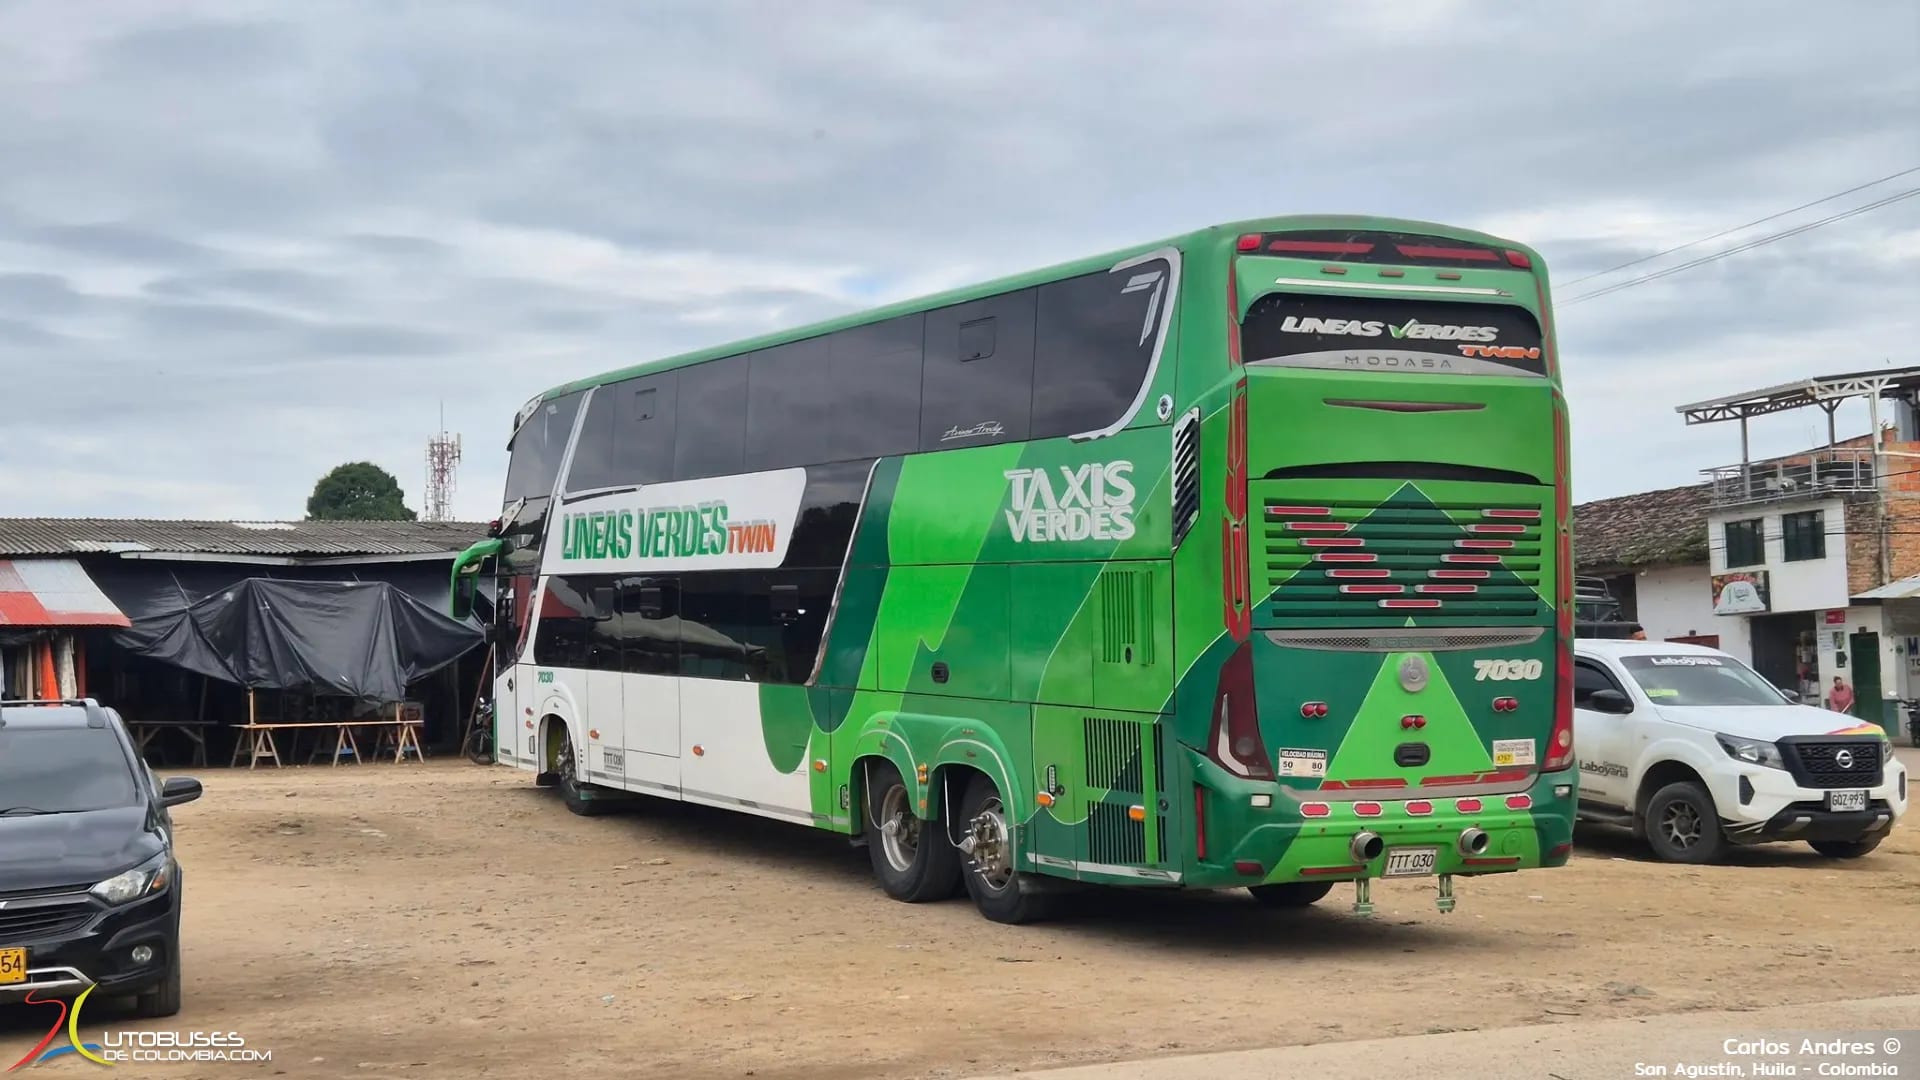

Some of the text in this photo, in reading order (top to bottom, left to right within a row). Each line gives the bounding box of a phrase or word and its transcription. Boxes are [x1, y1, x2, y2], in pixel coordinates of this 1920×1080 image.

[1281, 316, 1499, 342] LINEAS VERDES
[1457, 344, 1541, 359] TWIN
[1344, 355, 1452, 369] MODASA
[1003, 460, 1136, 511] TAXIS
[562, 500, 776, 560] LINEAS VERDES TWIN
[1004, 505, 1136, 543] VERDES
[538, 671, 554, 683] 7030
[1473, 659, 1543, 681] 7030
[1283, 761, 1323, 770] 50 80
[1579, 760, 1629, 778] Laboyana
[1, 955, 21, 974] 54
